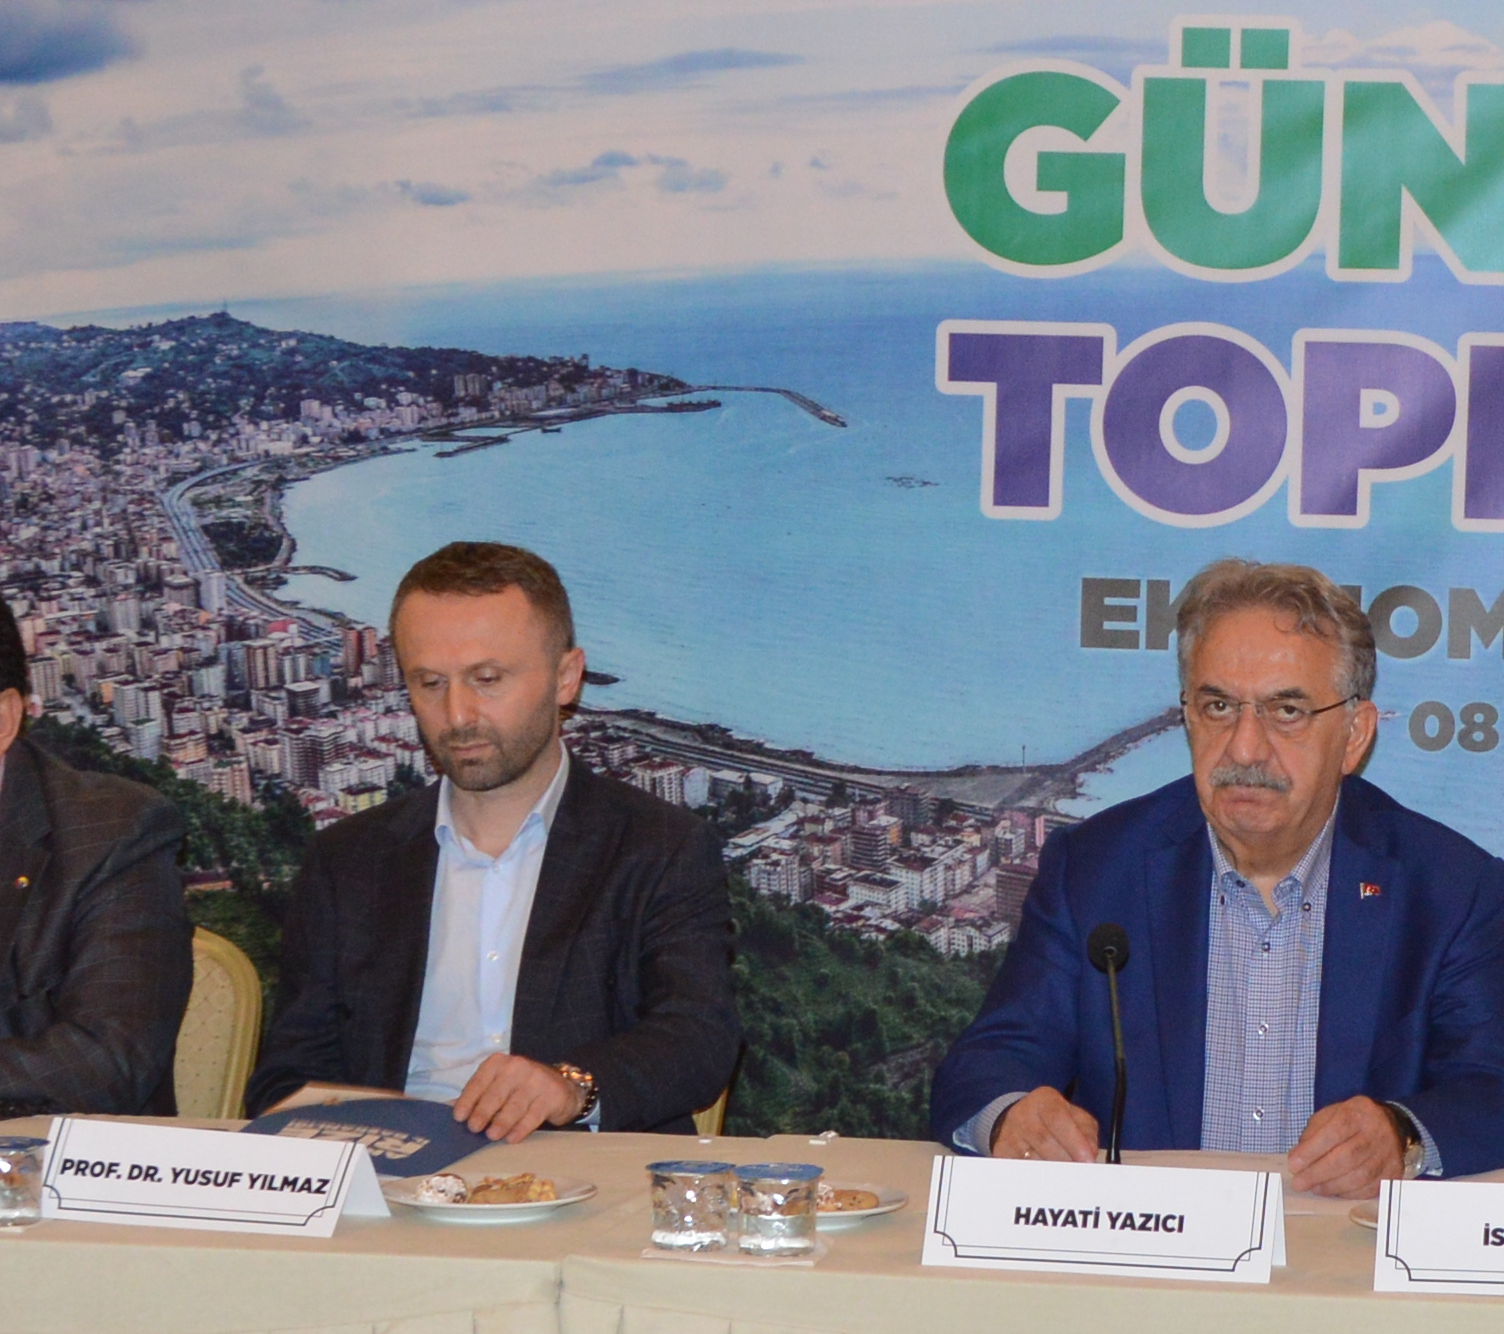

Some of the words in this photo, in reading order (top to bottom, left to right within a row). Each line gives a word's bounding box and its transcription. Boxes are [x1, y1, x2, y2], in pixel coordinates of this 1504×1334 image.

[1407, 700, 1500, 753] 08
[59, 1158, 122, 1180] PROF.
[126, 1163, 163, 1183] DR.
[170, 1167, 243, 1189] YUSUF
[247, 1172, 331, 1195] YILMAZ
[1013, 1205, 1101, 1230] HAYATİ
[1106, 1210, 1186, 1234] YAZICI
